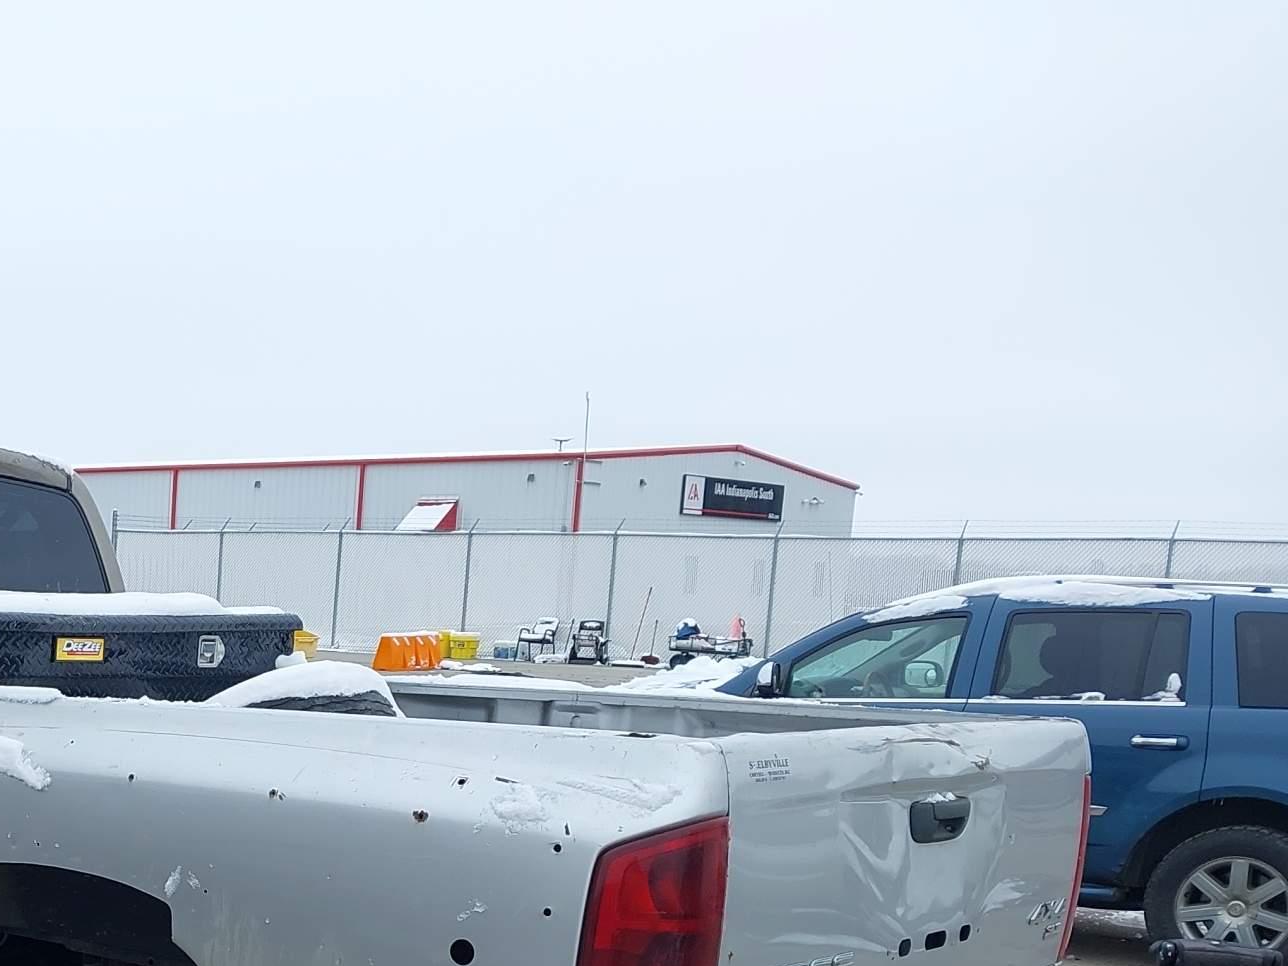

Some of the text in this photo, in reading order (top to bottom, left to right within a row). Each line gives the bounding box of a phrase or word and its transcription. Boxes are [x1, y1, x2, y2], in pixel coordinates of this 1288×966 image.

[714, 482, 774, 501] IAA Indianapolis South
